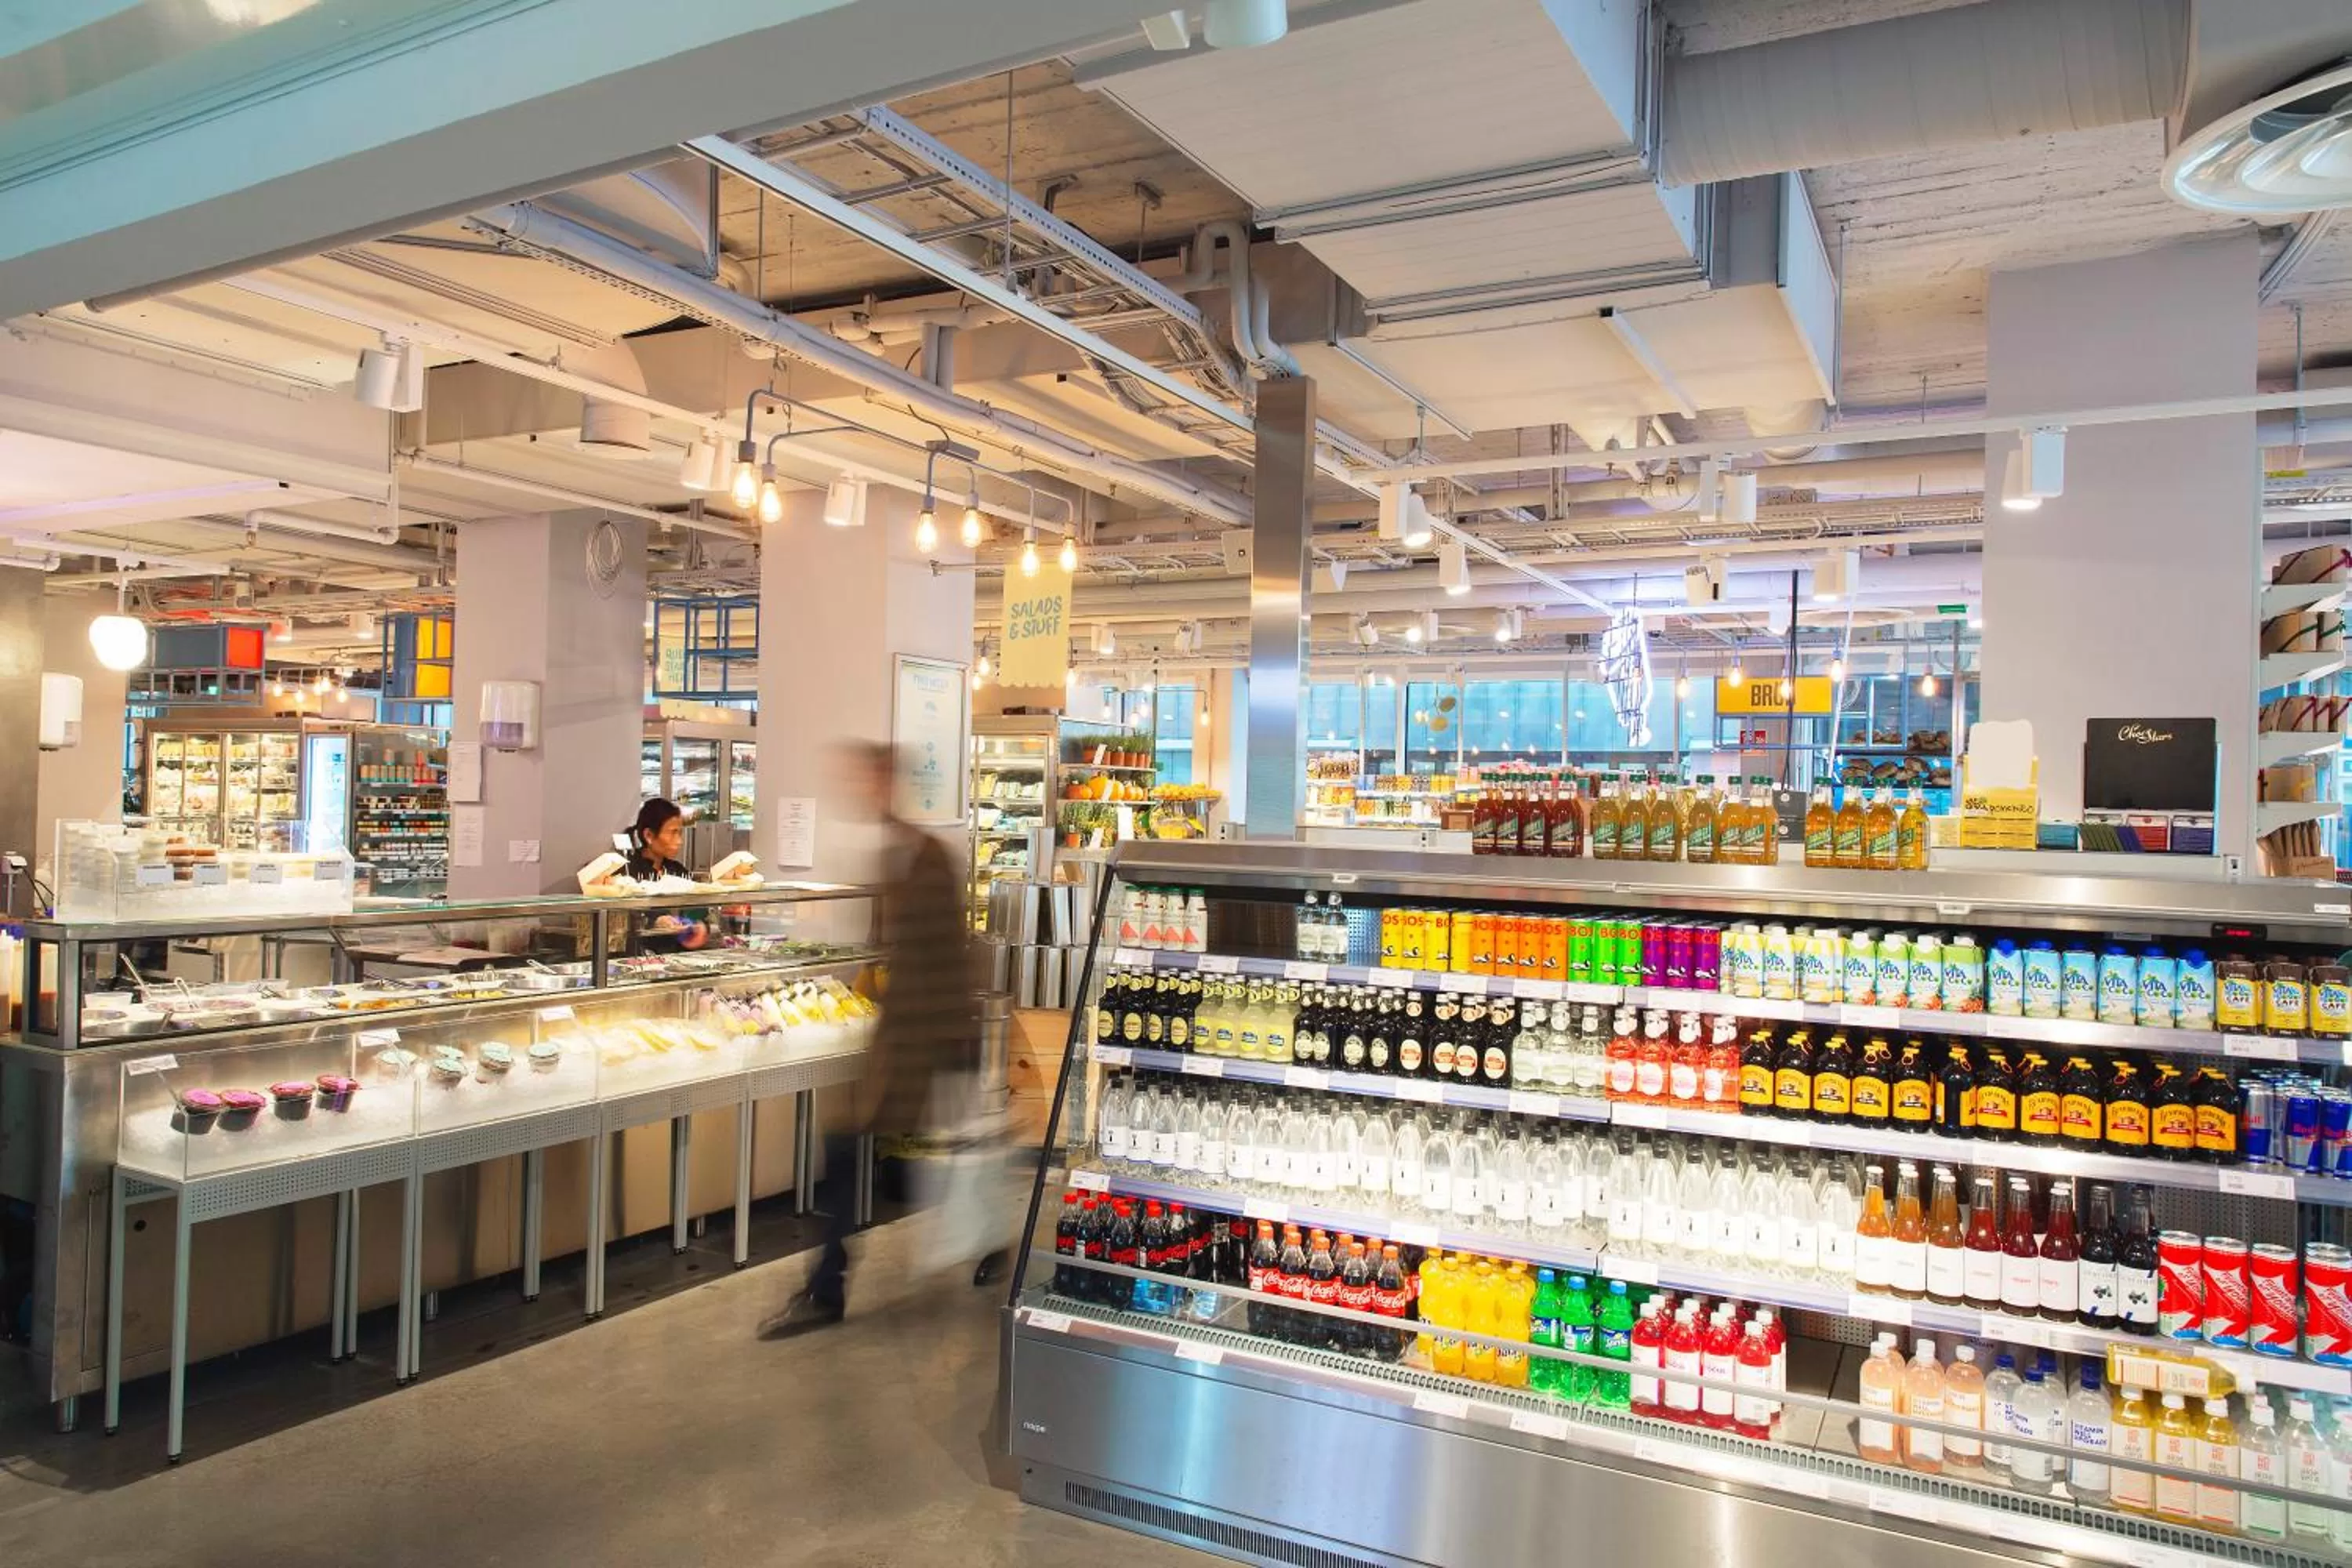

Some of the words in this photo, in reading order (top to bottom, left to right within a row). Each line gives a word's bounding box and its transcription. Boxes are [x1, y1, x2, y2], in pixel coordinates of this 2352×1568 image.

[1011, 596, 1062, 619] SALADS
[1009, 622, 1019, 640] &
[1022, 615, 1061, 638] STUFF
